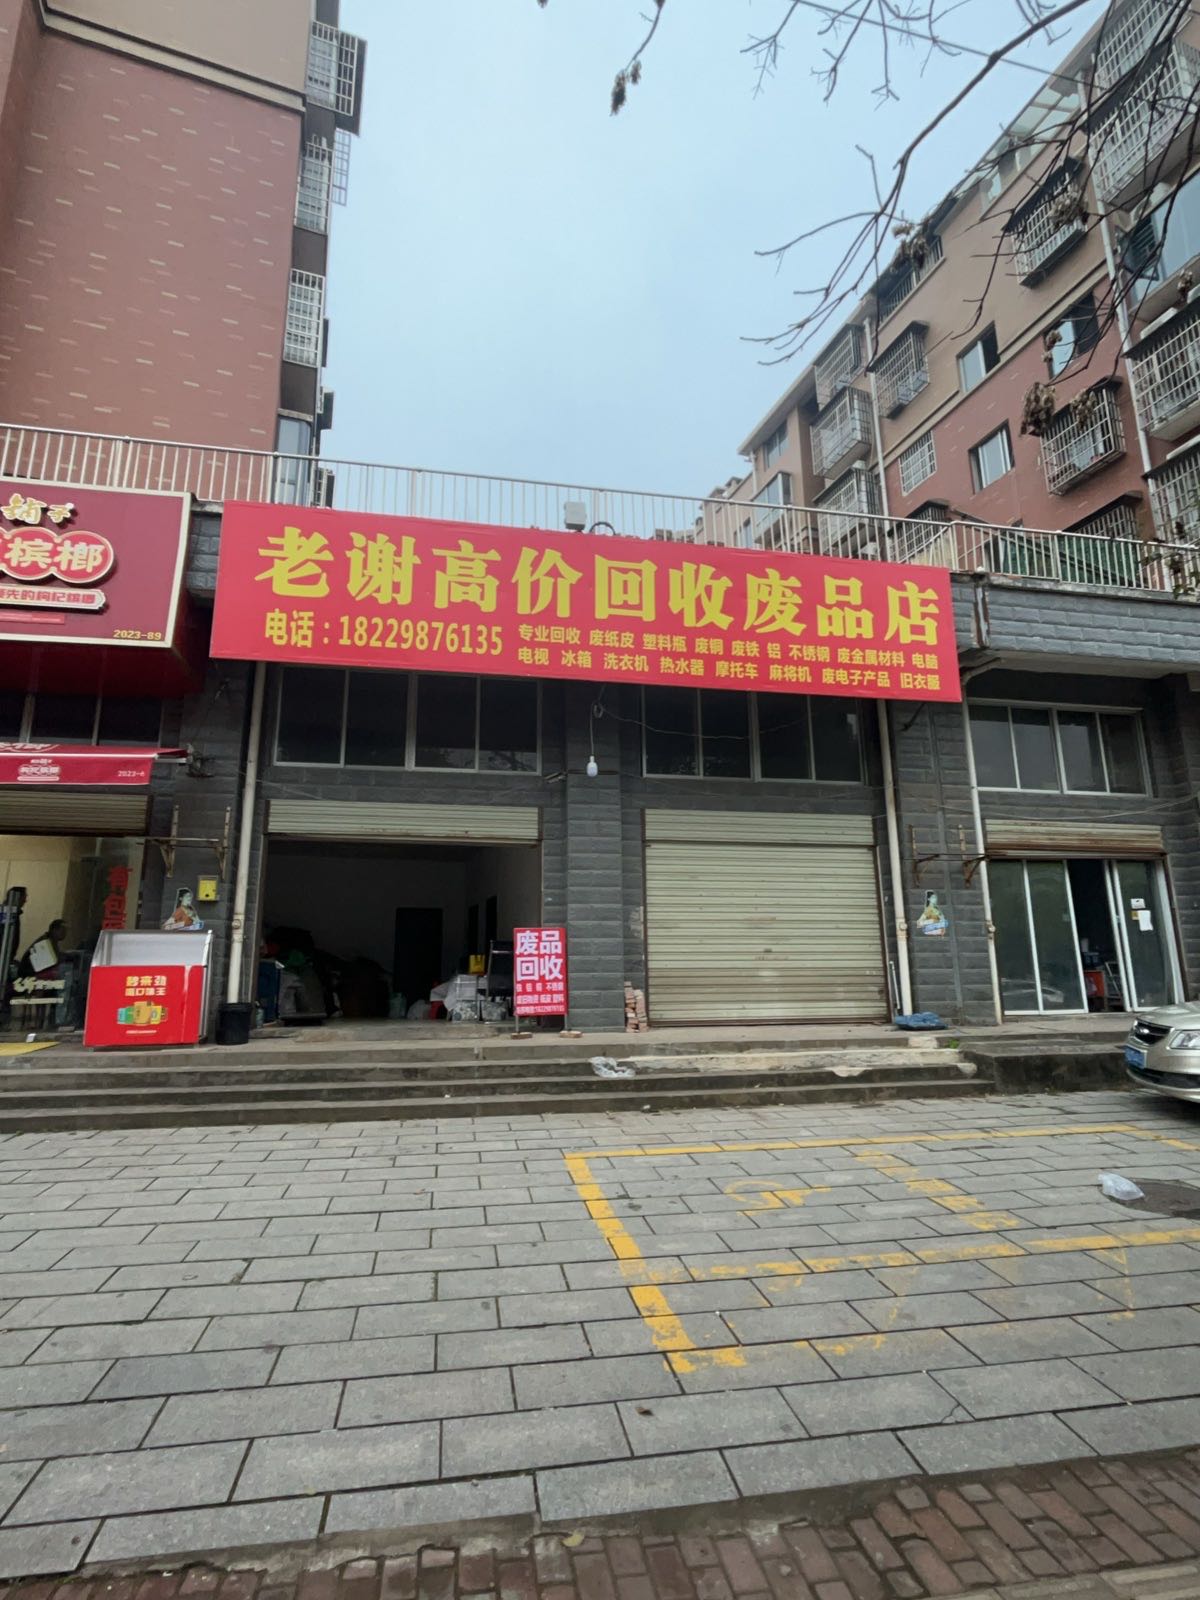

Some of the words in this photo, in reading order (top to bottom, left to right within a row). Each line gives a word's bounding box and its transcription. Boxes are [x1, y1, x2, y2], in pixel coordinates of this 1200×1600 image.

[255, 526, 939, 645] 老谢高价回收废品店
[518, 624, 581, 645] 专业回收
[589, 630, 635, 649] 废纸皮
[642, 633, 687, 653] 塑料瓶
[695, 637, 724, 655] 废铜
[731, 640, 760, 658] 废铁
[767, 642, 782, 660] 铝
[789, 644, 830, 663] 不锈钢
[837, 648, 905, 667] 废金属材料
[912, 652, 938, 669] 电脑
[518, 647, 549, 666] 电视
[561, 650, 592, 669] 冰箱
[603, 653, 649, 672] 洗衣机
[660, 657, 705, 676] 热水器
[715, 661, 759, 679] 摩托车
[769, 664, 812, 682] 麻将机
[822, 667, 890, 687] 废电子产品
[899, 672, 940, 690] 旧衣服
[516, 930, 562, 955] 废品
[516, 956, 563, 981] 回收
